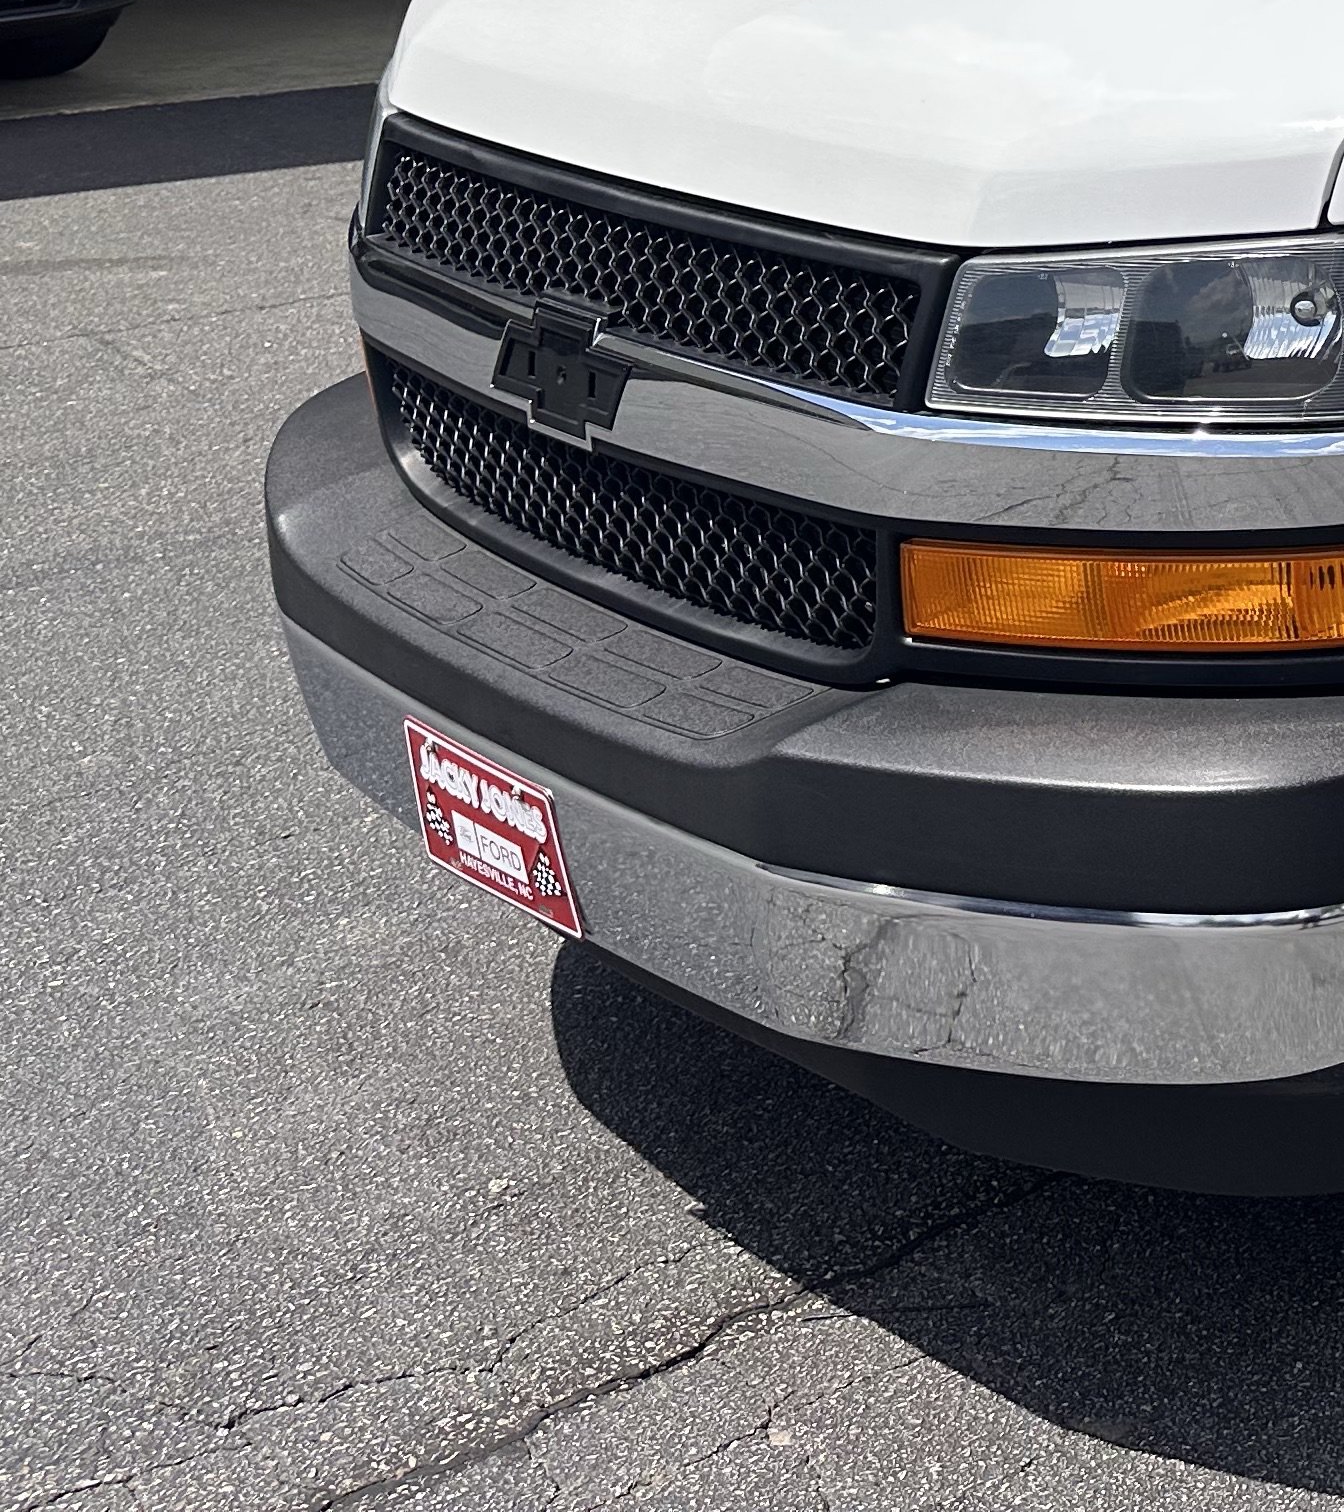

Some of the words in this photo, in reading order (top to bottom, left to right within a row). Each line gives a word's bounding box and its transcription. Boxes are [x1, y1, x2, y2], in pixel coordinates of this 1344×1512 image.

[420, 740, 480, 809] JACKY
[480, 778, 548, 845] JONES
[480, 834, 522, 872] FORD
